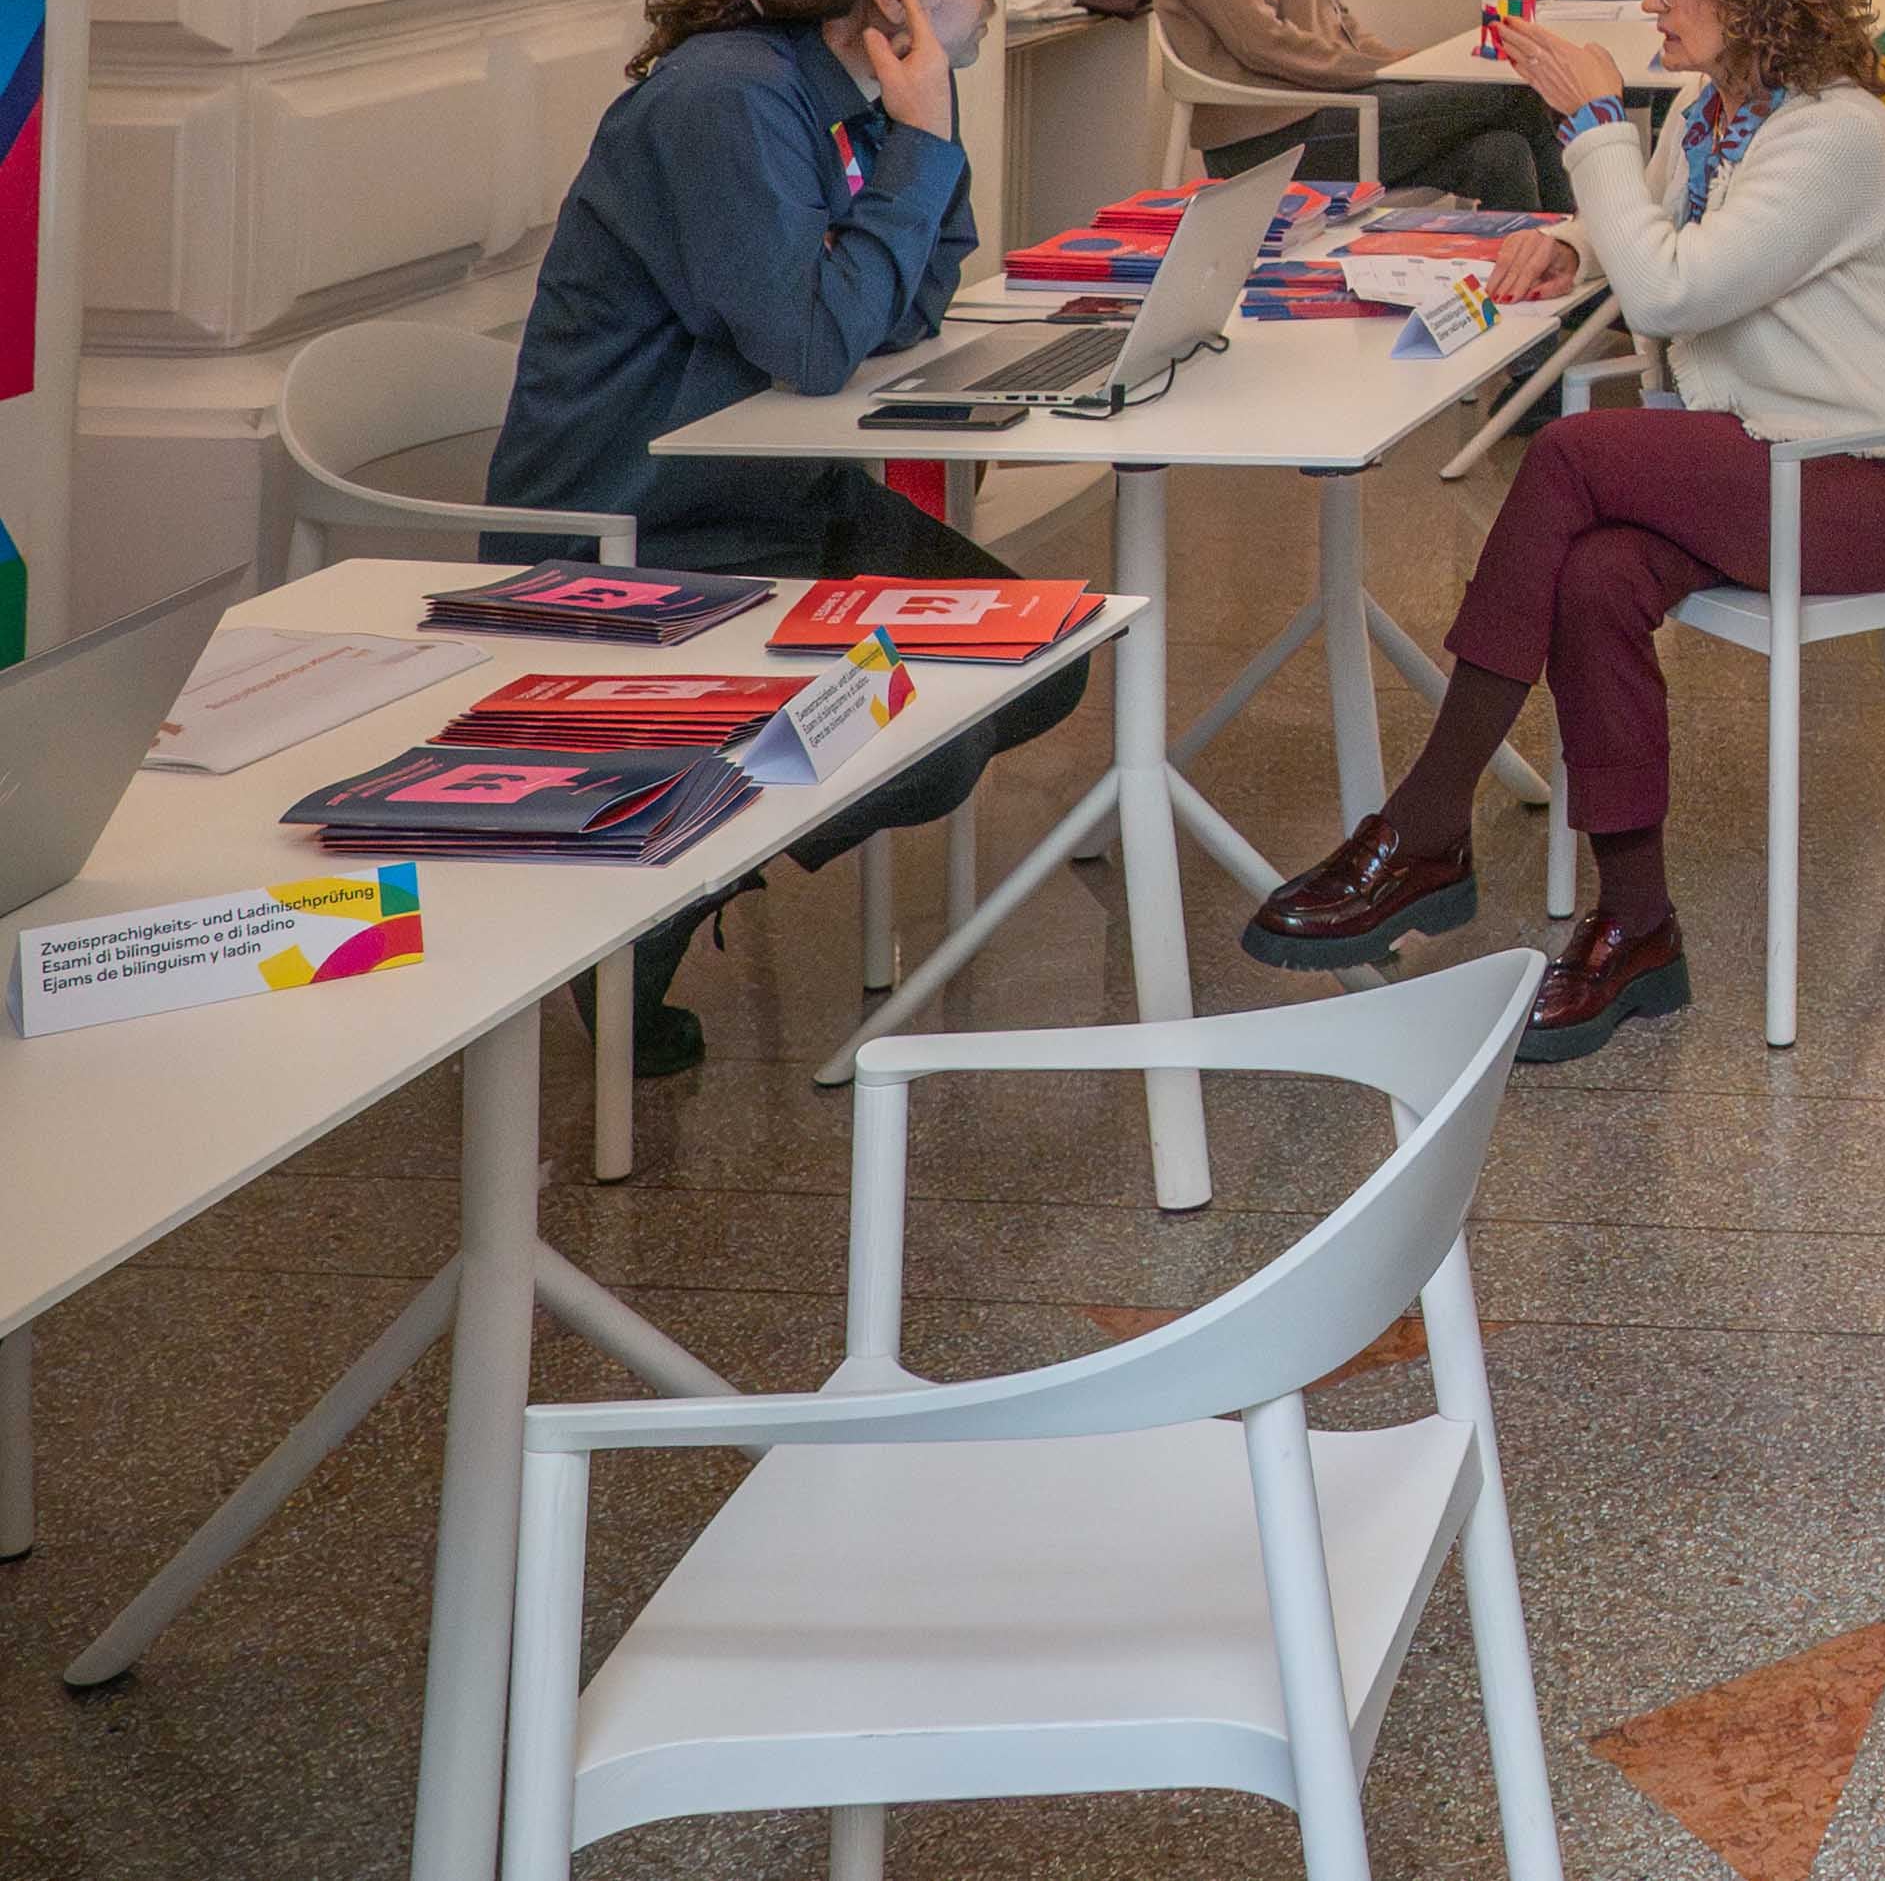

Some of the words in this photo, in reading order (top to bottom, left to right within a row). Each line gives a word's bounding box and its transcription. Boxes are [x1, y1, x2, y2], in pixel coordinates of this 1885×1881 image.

[41, 918, 199, 956] Zweisprachigkeits-
[202, 909, 233, 927] und
[237, 886, 375, 921] Ladinischprüfung
[42, 952, 92, 974] Esami
[96, 949, 112, 964] di
[115, 934, 210, 962] bilinguismo
[214, 932, 224, 942] e
[228, 924, 243, 939] di
[246, 919, 295, 936] ladino
[42, 973, 93, 995] Ejams
[96, 967, 118, 982] de
[122, 952, 206, 978] bilinguism
[211, 950, 219, 964] y
[223, 941, 262, 959] ladin
